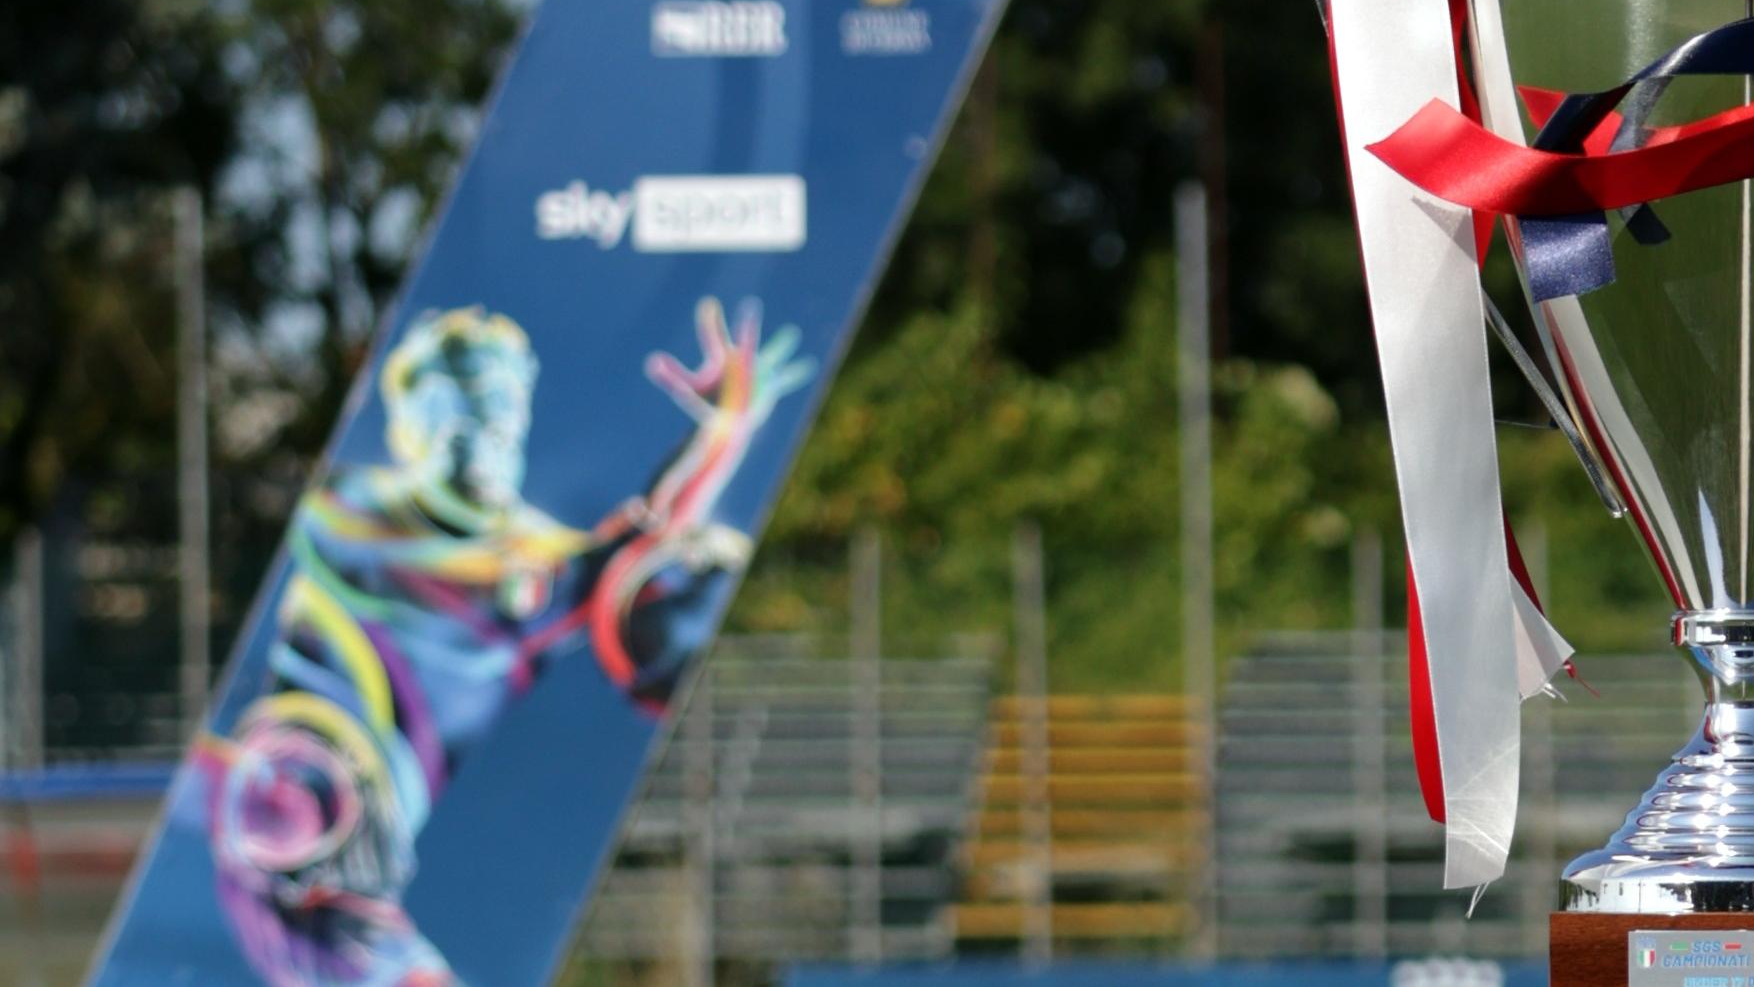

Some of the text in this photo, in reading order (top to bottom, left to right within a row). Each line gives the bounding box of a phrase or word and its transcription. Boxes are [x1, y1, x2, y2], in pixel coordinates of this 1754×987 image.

[535, 178, 633, 250] sky
[1692, 940, 1722, 953] SGS
[1662, 954, 1750, 967] CAMPIONATI
